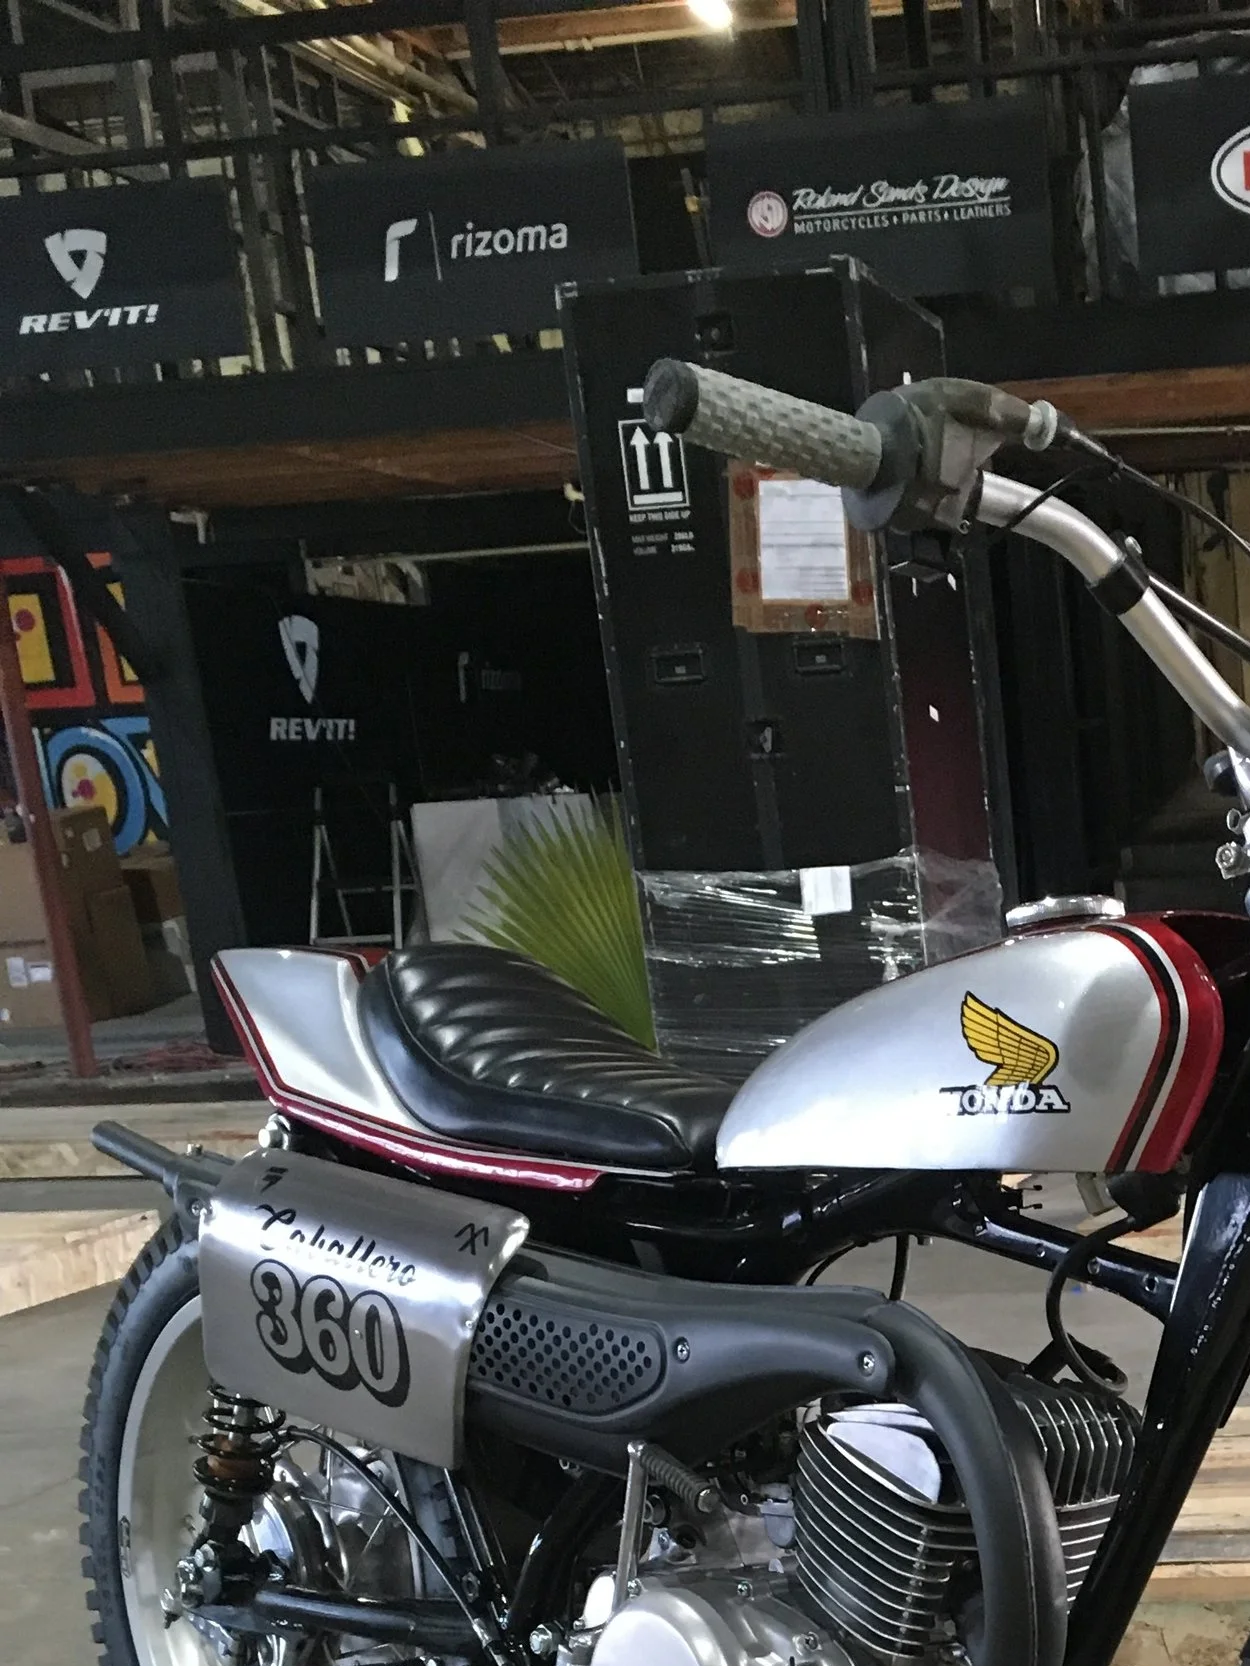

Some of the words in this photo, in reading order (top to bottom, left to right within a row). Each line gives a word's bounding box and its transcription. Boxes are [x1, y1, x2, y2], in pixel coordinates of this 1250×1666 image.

[792, 185, 863, 211] Roland
[862, 180, 929, 207] Sands
[932, 173, 1010, 200] Design
[795, 215, 890, 235] MOTORCYCLES
[902, 211, 942, 224] PARTS
[953, 203, 1012, 220] LEATHERS
[451, 221, 568, 259] rizoma
[19, 303, 160, 335] REV'IT!
[270, 717, 355, 741] REV'IT!
[255, 1203, 418, 1286] Caballero
[250, 1258, 411, 1408] 360
